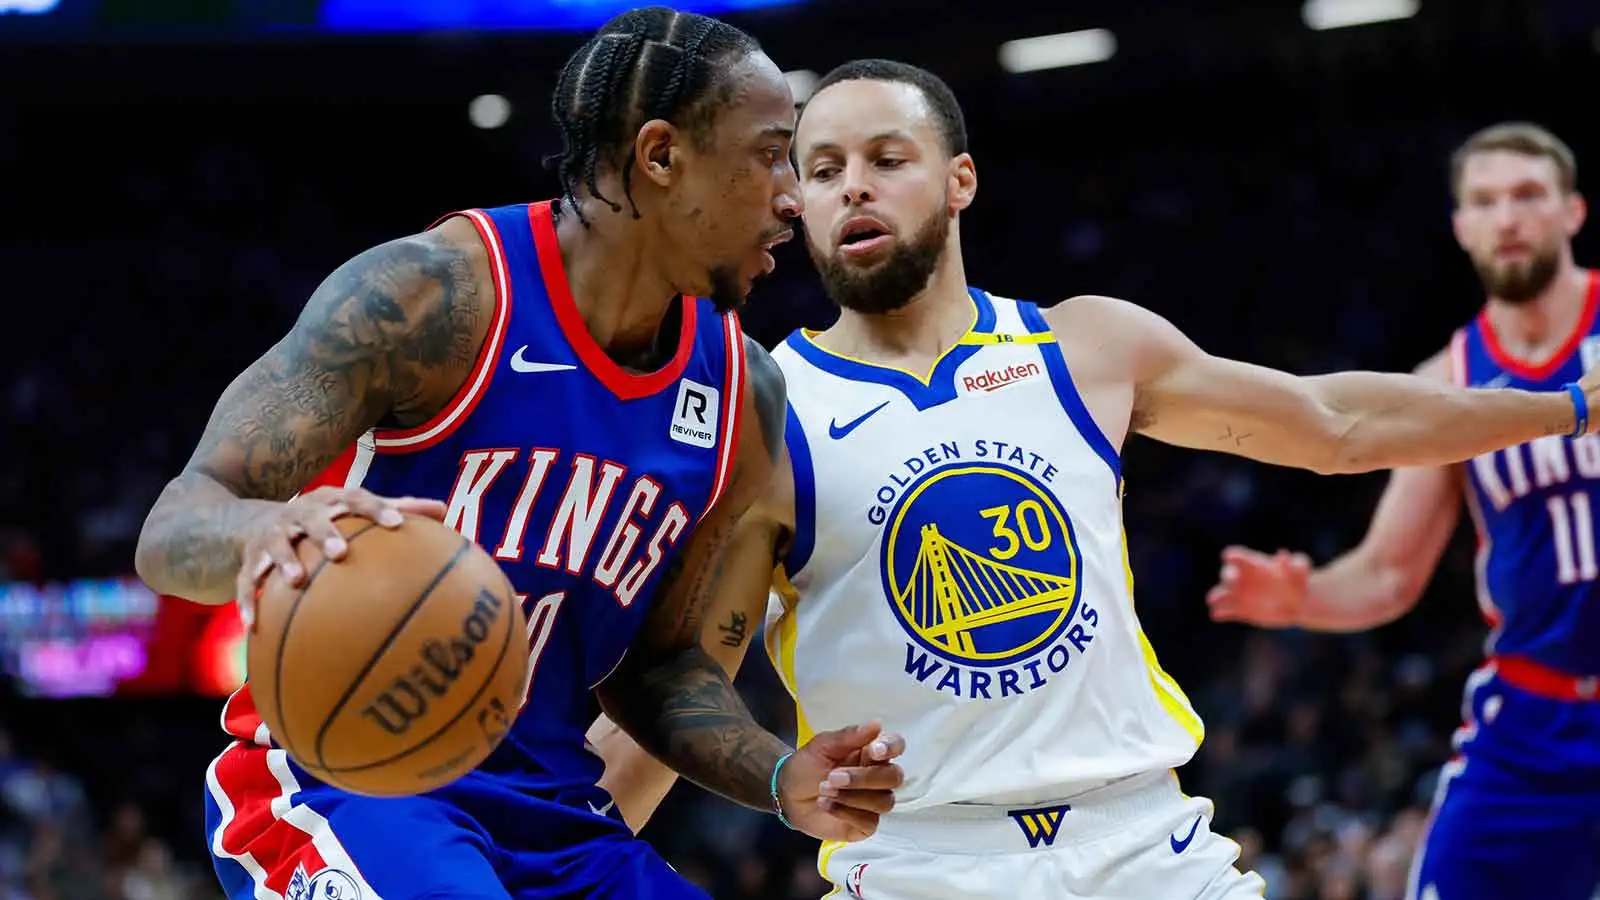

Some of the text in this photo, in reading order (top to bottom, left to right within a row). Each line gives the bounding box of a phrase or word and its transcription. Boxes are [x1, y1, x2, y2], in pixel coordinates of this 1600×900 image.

[681, 388, 707, 425] R
[963, 362, 1040, 392] Rakuten
[672, 424, 712, 441] REVIVER
[868, 439, 1059, 526] GOLDEN STATE
[443, 448, 691, 607] KINGS
[979, 499, 1052, 561] 30
[1546, 492, 1598, 584] 11
[361, 586, 502, 736] Wilson
[904, 602, 1099, 700] WARRIORS
